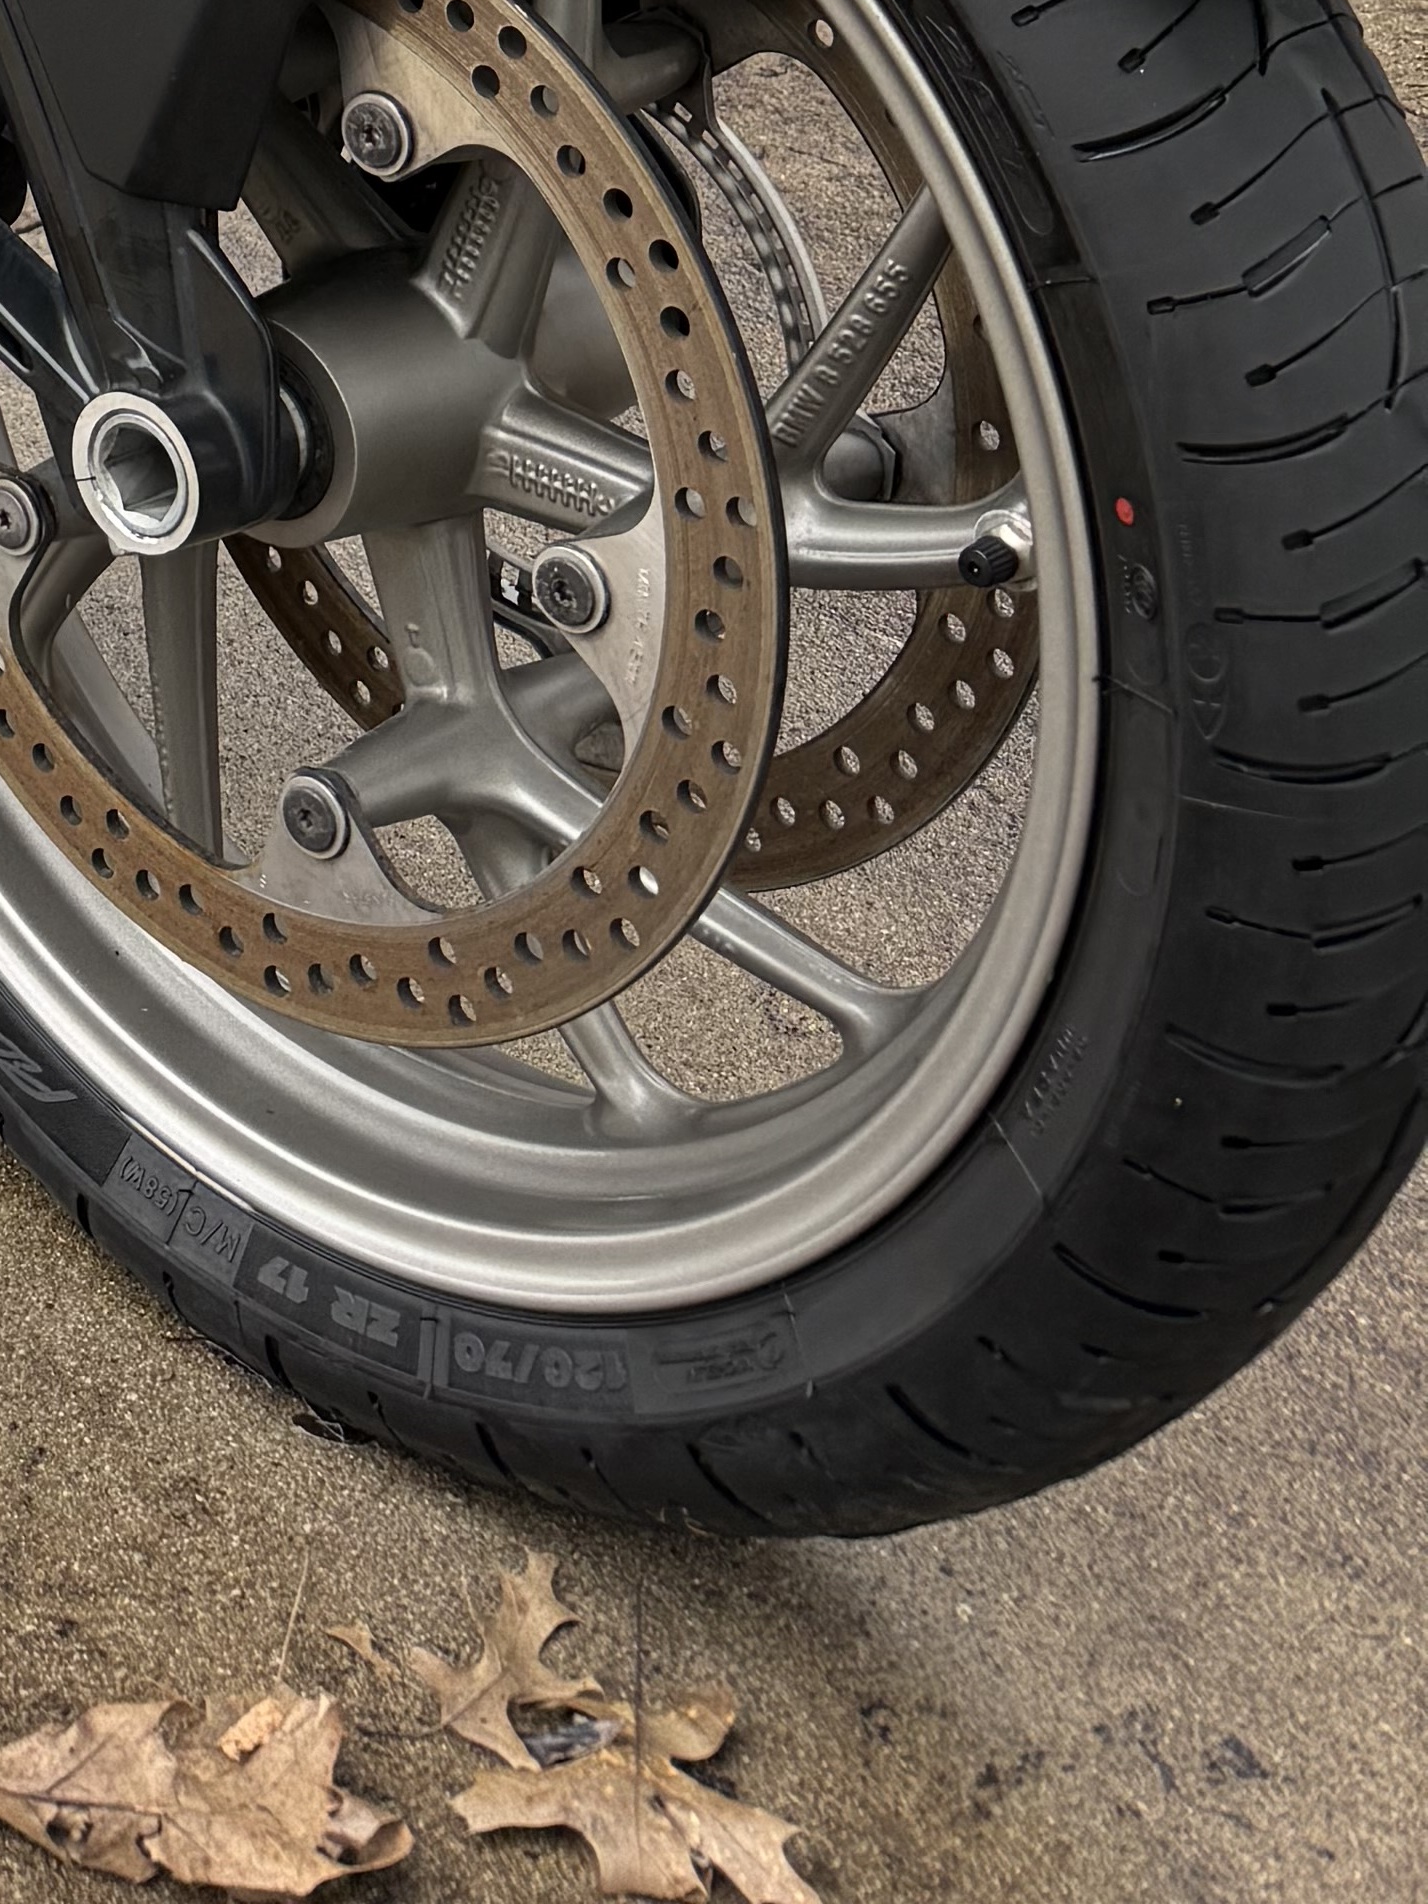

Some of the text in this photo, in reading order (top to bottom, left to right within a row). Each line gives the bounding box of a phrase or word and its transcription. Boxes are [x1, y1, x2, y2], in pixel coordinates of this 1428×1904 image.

[771, 383, 825, 448] BMW
[864, 258, 910, 314] 655
[119, 1155, 179, 1217] (58W)
[185, 1206, 242, 1263] M/C
[257, 1256, 309, 1304] 17
[330, 1284, 402, 1348] ZR
[453, 1330, 628, 1391] 120/70
